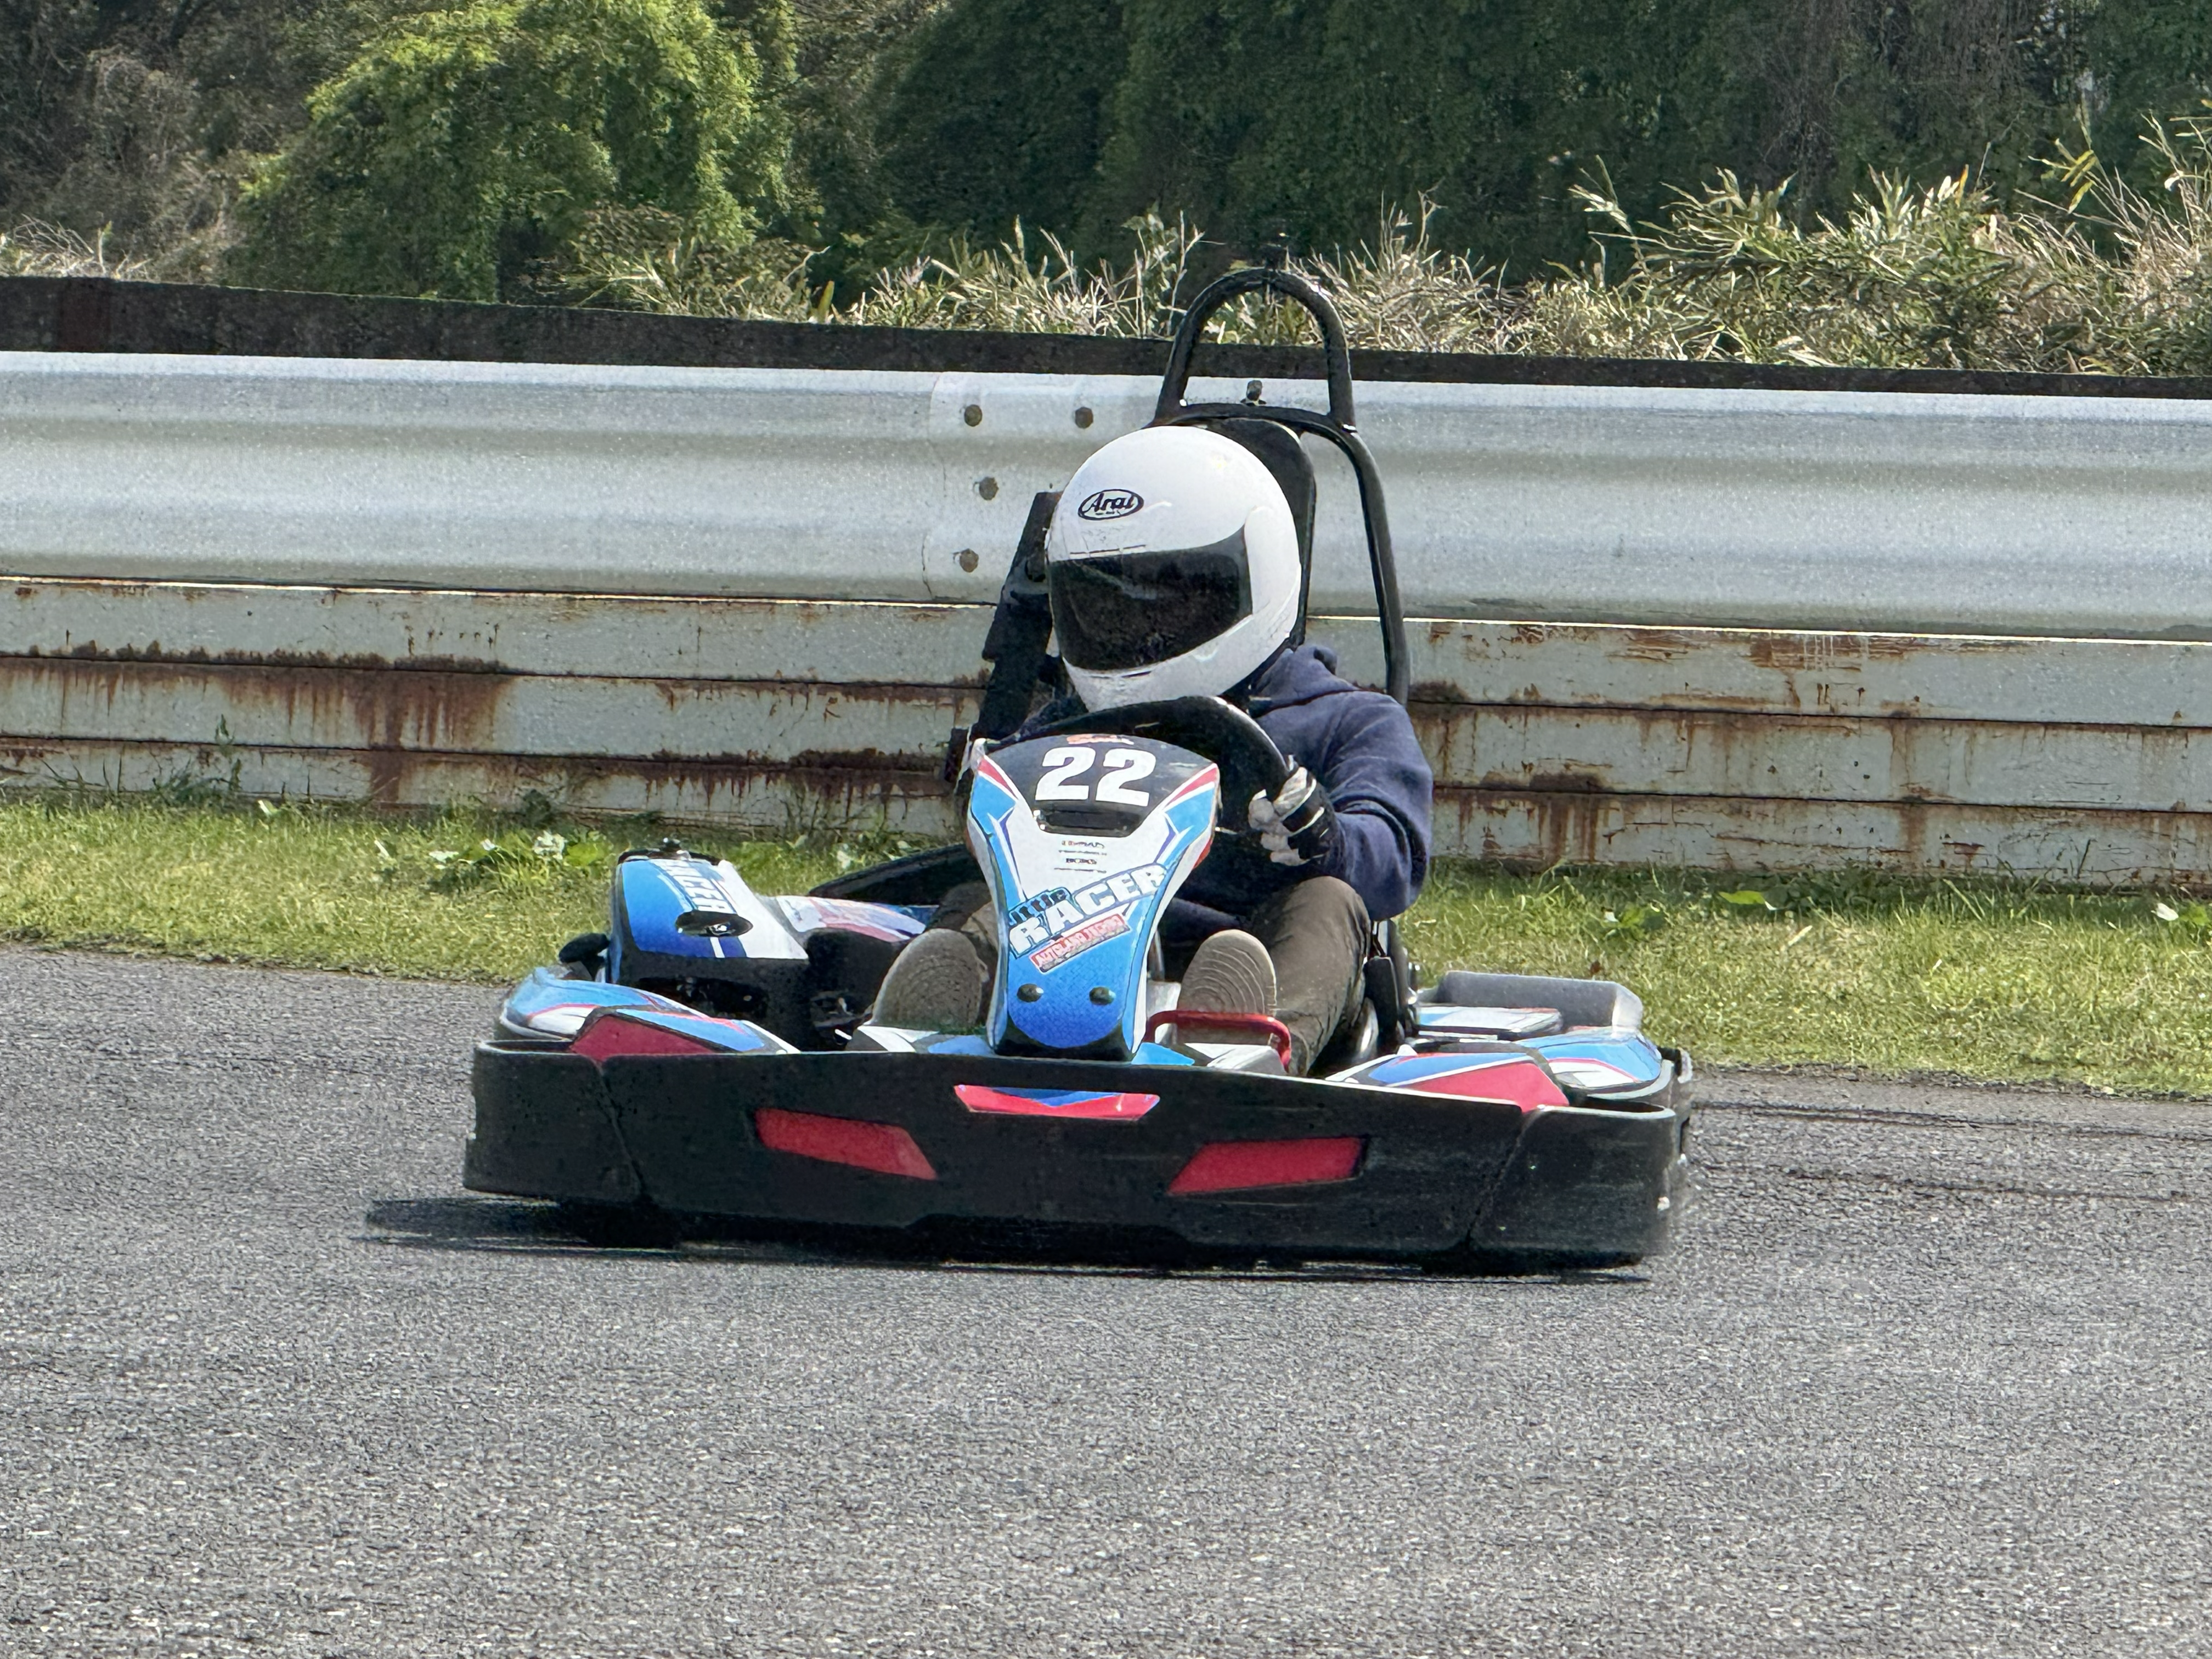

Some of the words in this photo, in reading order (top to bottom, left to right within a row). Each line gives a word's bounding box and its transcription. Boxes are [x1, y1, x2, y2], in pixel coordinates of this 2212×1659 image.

[1083, 493, 1135, 513] Arai
[1035, 746, 1156, 806] 22
[1009, 889, 1068, 926] ittle
[1009, 864, 1167, 955] RACER
